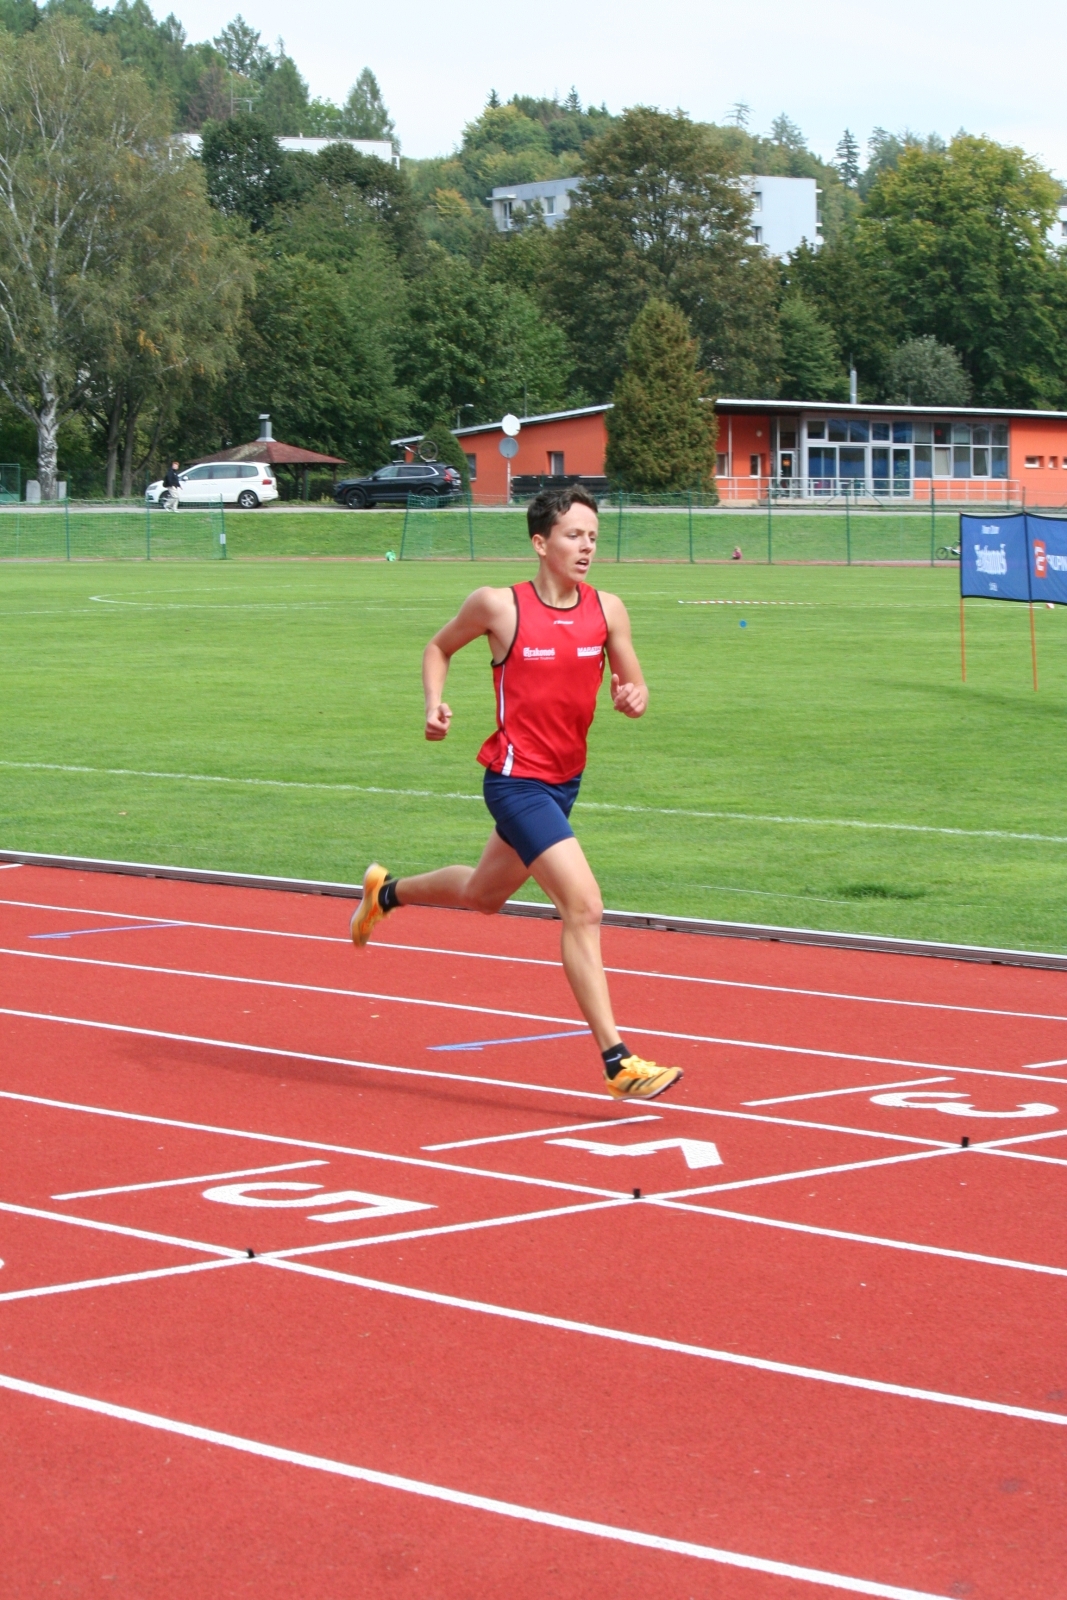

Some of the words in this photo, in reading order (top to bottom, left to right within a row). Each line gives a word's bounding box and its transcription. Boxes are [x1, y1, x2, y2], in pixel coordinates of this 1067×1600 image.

[868, 1091, 1060, 1119] 3
[544, 1136, 724, 1170] 4
[201, 1181, 438, 1224] 5
